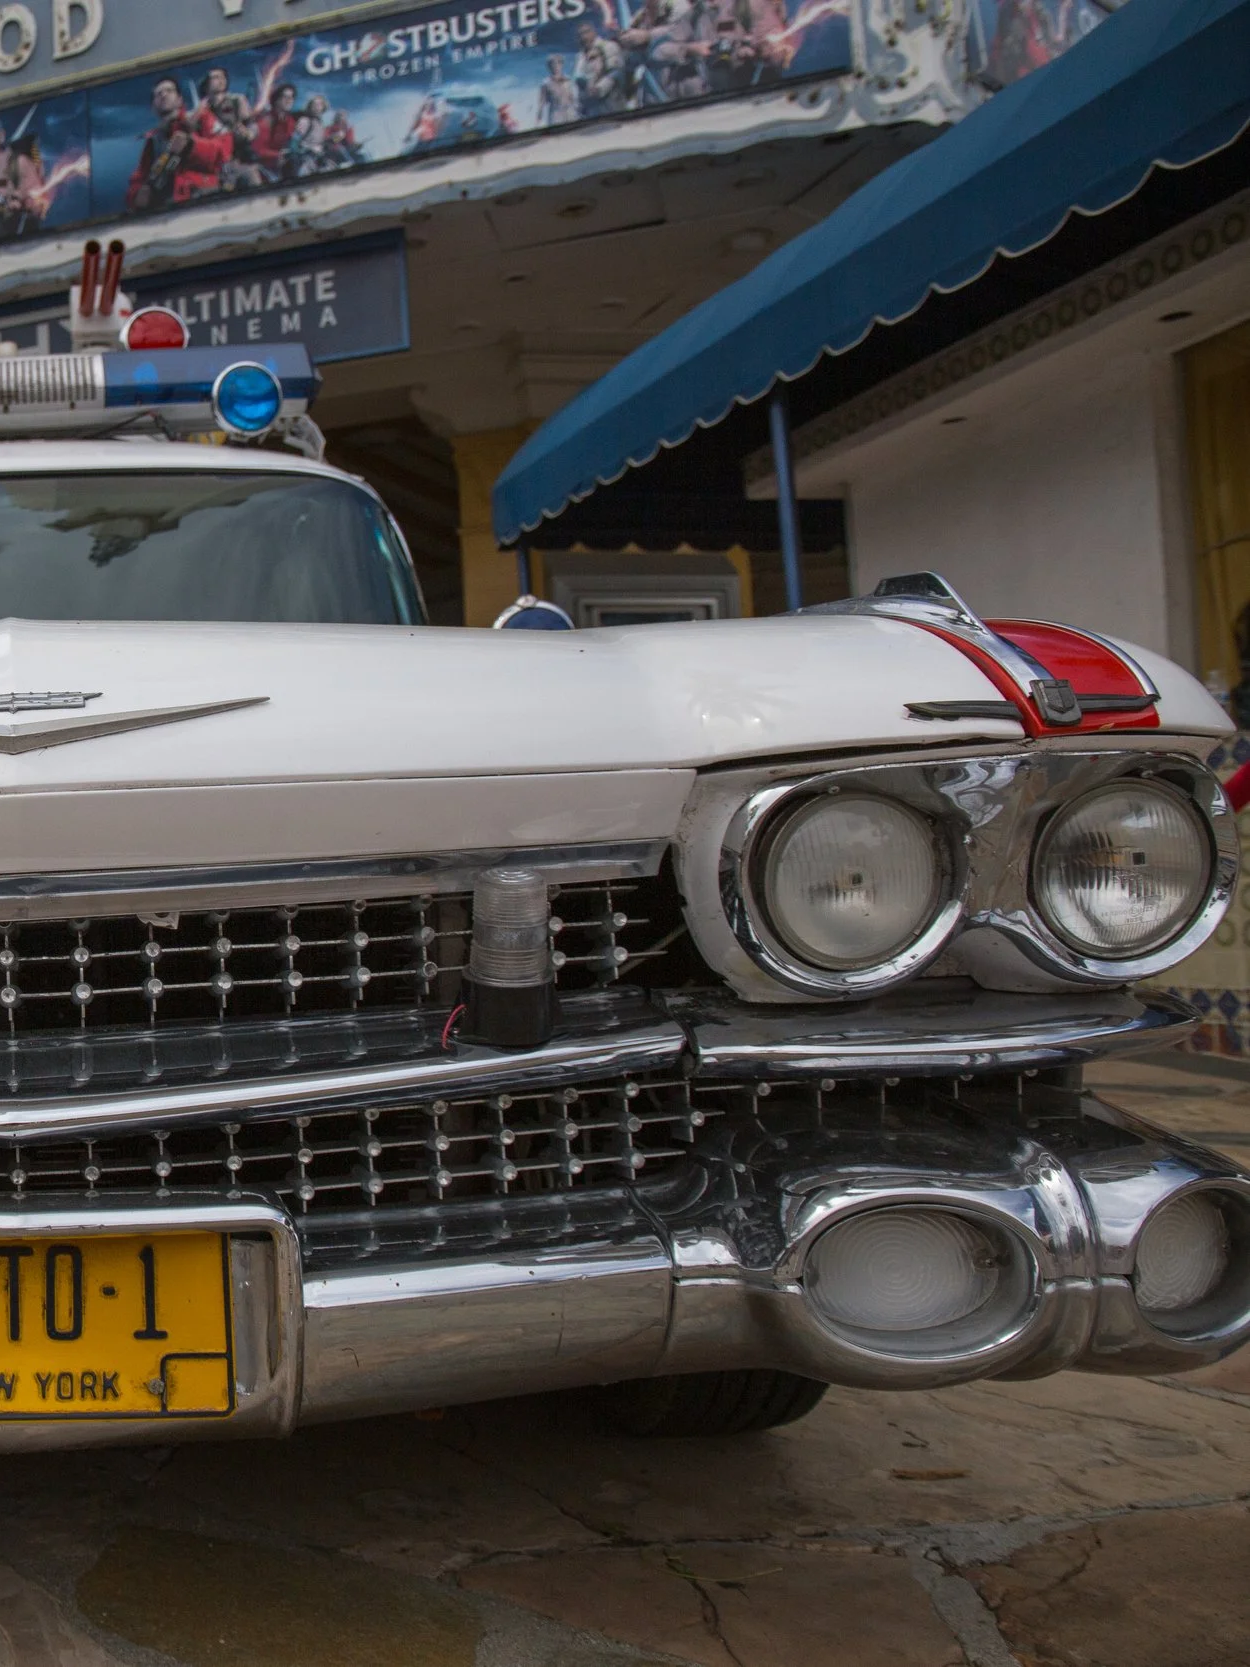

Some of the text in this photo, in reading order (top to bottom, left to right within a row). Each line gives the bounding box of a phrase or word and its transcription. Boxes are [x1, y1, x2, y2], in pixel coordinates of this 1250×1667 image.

[351, 31, 539, 86] FROZEN EMPIRE
[35, 1371, 120, 1401] YORK
